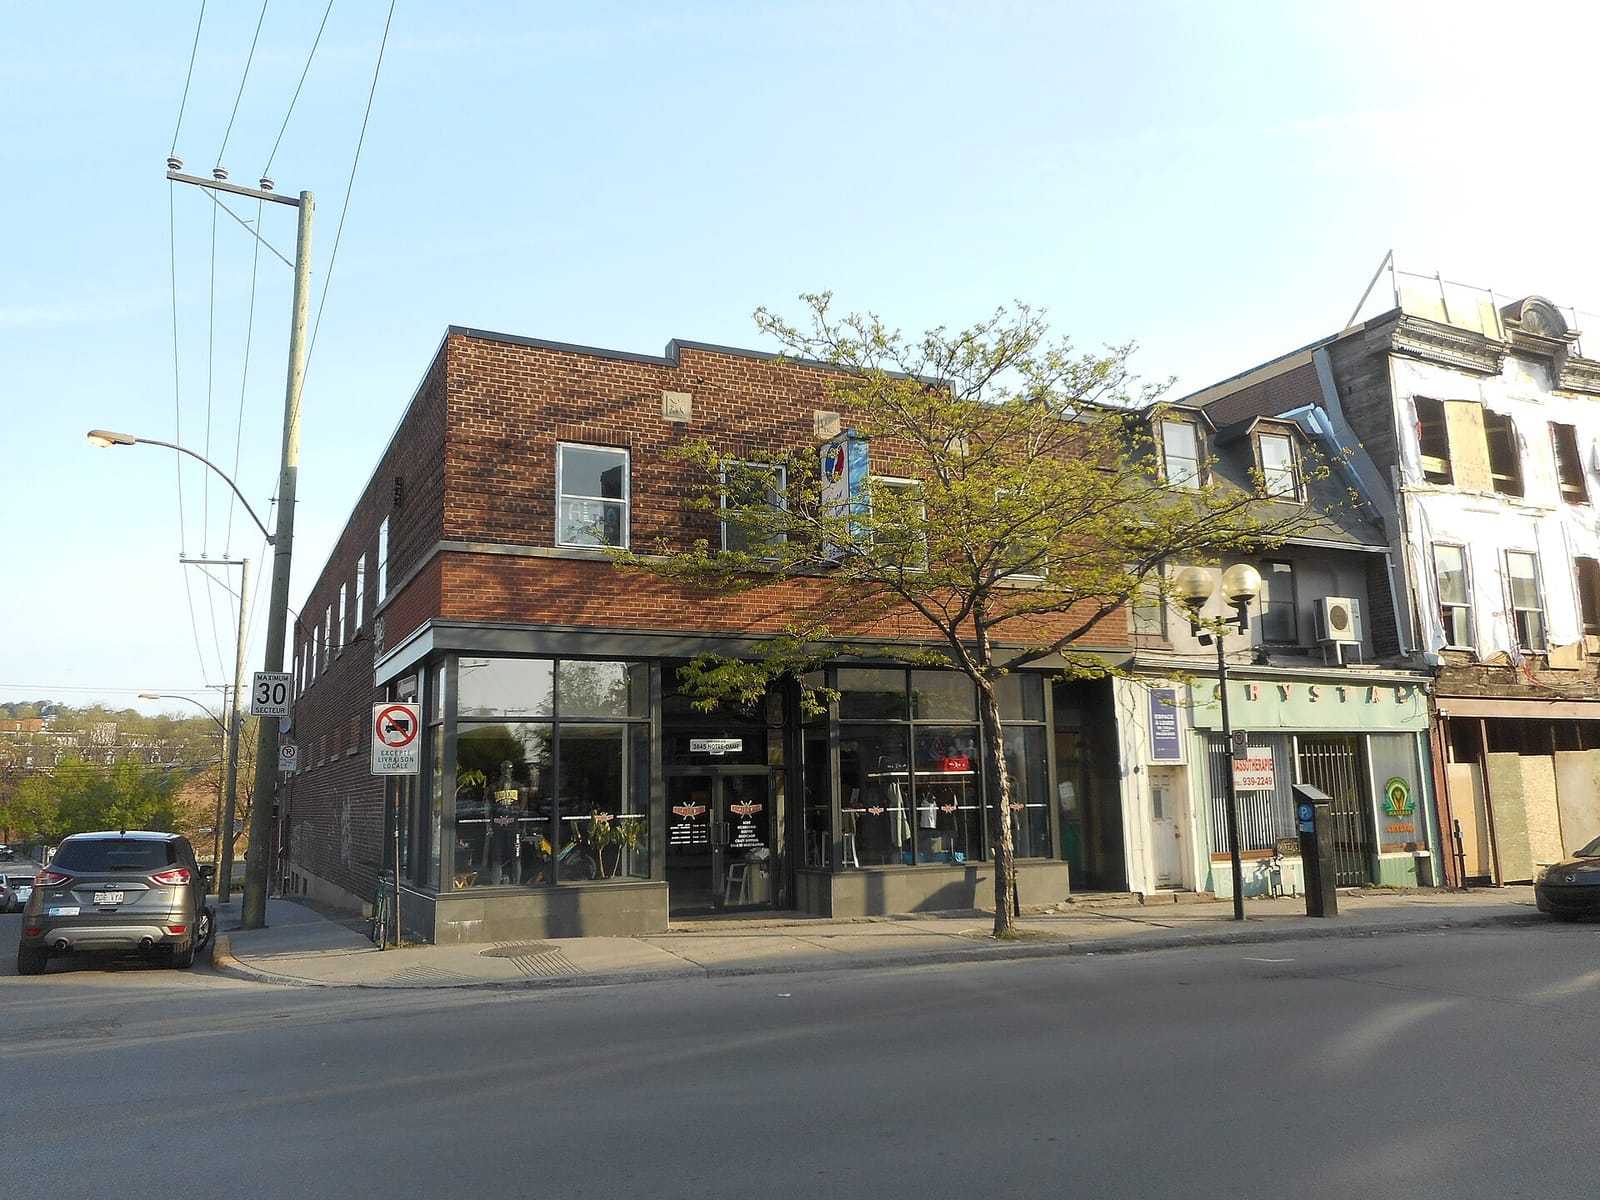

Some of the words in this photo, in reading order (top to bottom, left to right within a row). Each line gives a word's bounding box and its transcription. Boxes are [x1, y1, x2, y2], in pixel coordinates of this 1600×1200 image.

[256, 674, 289, 682] MAXIMUM
[256, 682, 287, 705] 30
[255, 706, 286, 714] SECTEUR
[377, 756, 414, 764] LIVRAISON
[1242, 776, 1273, 786] 939-2249
